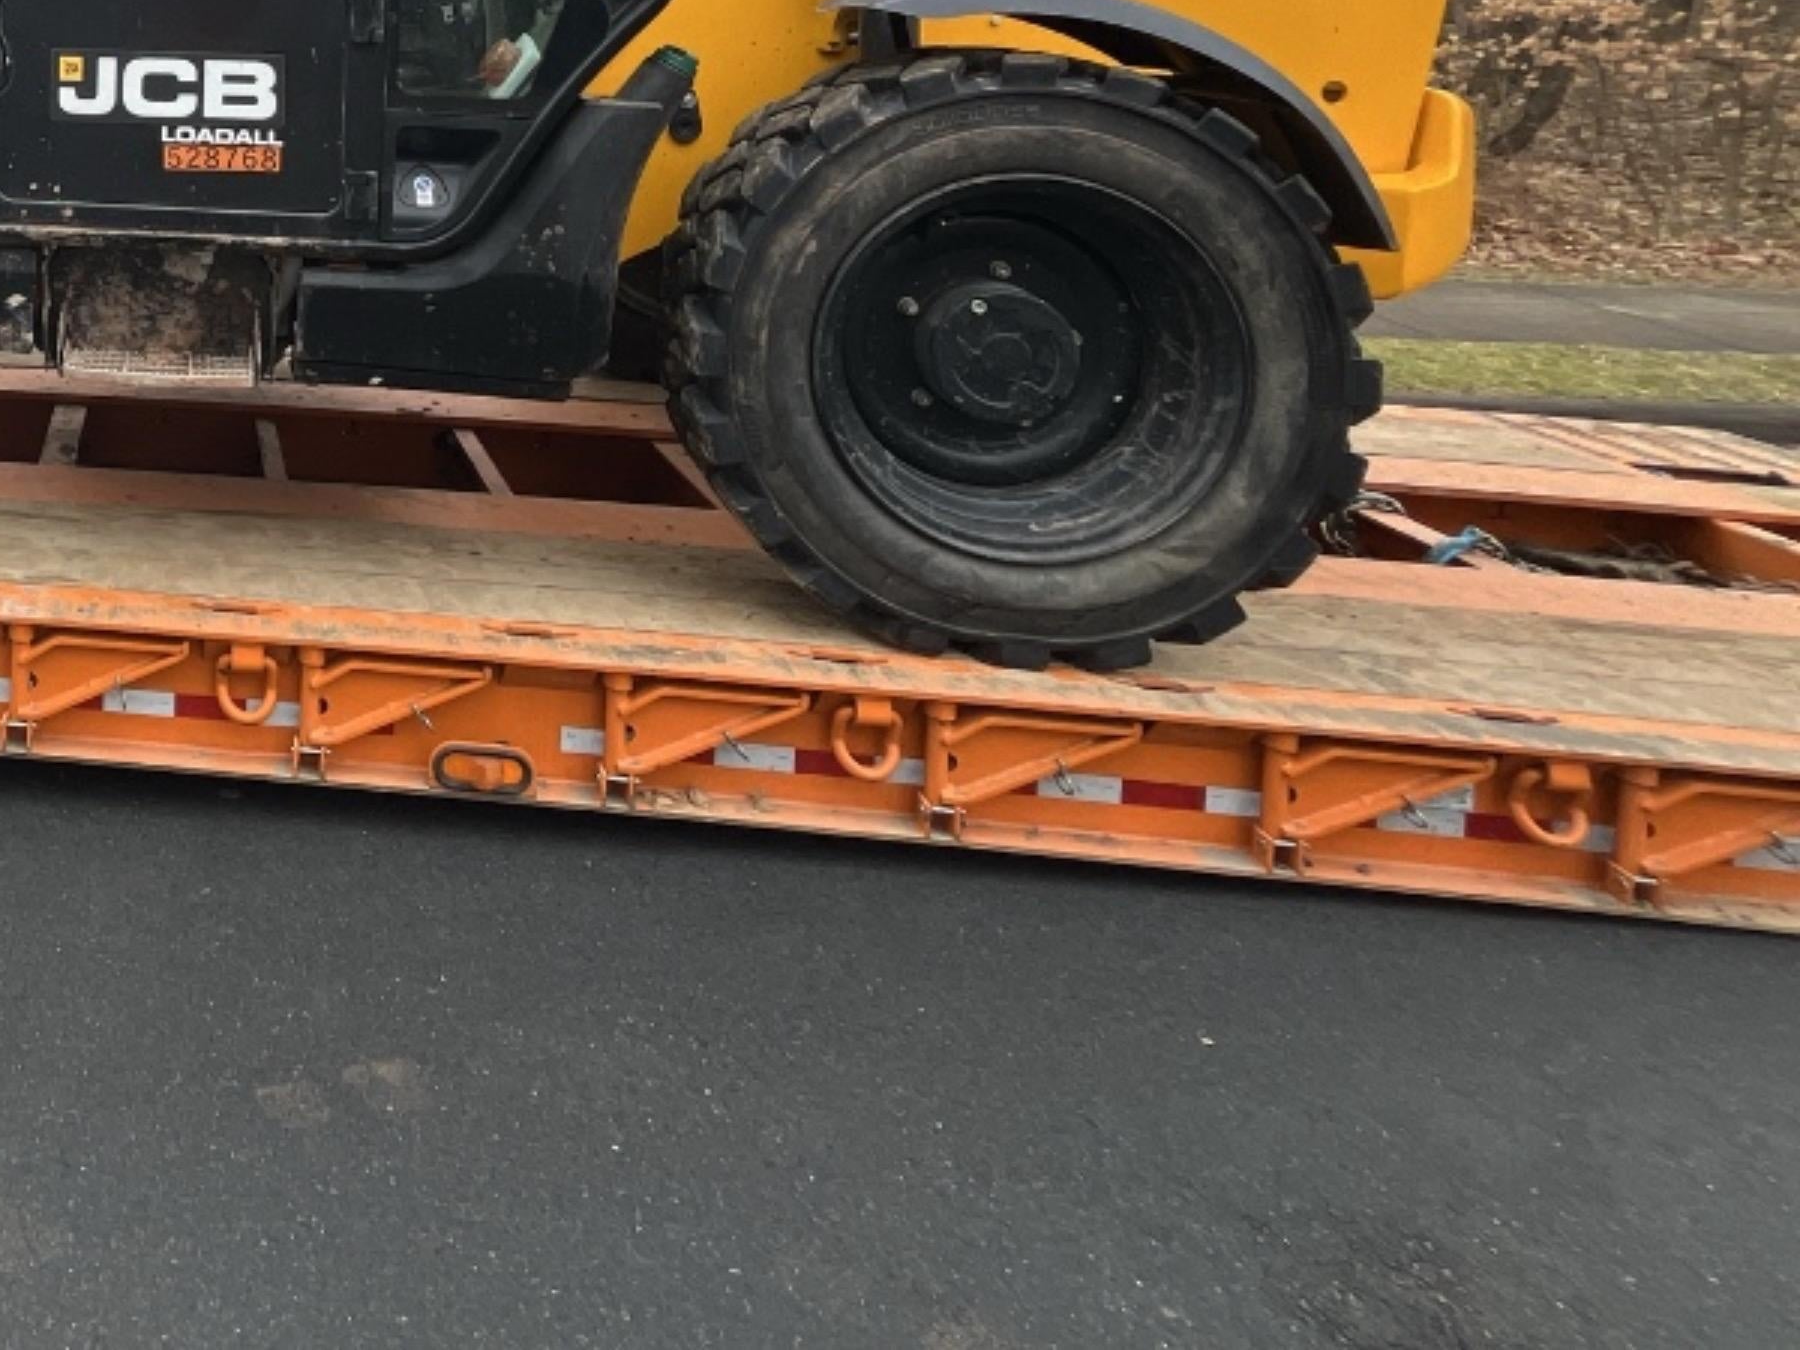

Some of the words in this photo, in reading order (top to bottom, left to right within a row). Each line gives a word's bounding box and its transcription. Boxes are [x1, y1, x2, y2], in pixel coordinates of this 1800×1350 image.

[58, 55, 278, 121] JCB
[160, 124, 284, 148] LOADALL
[166, 147, 278, 171] 528768
